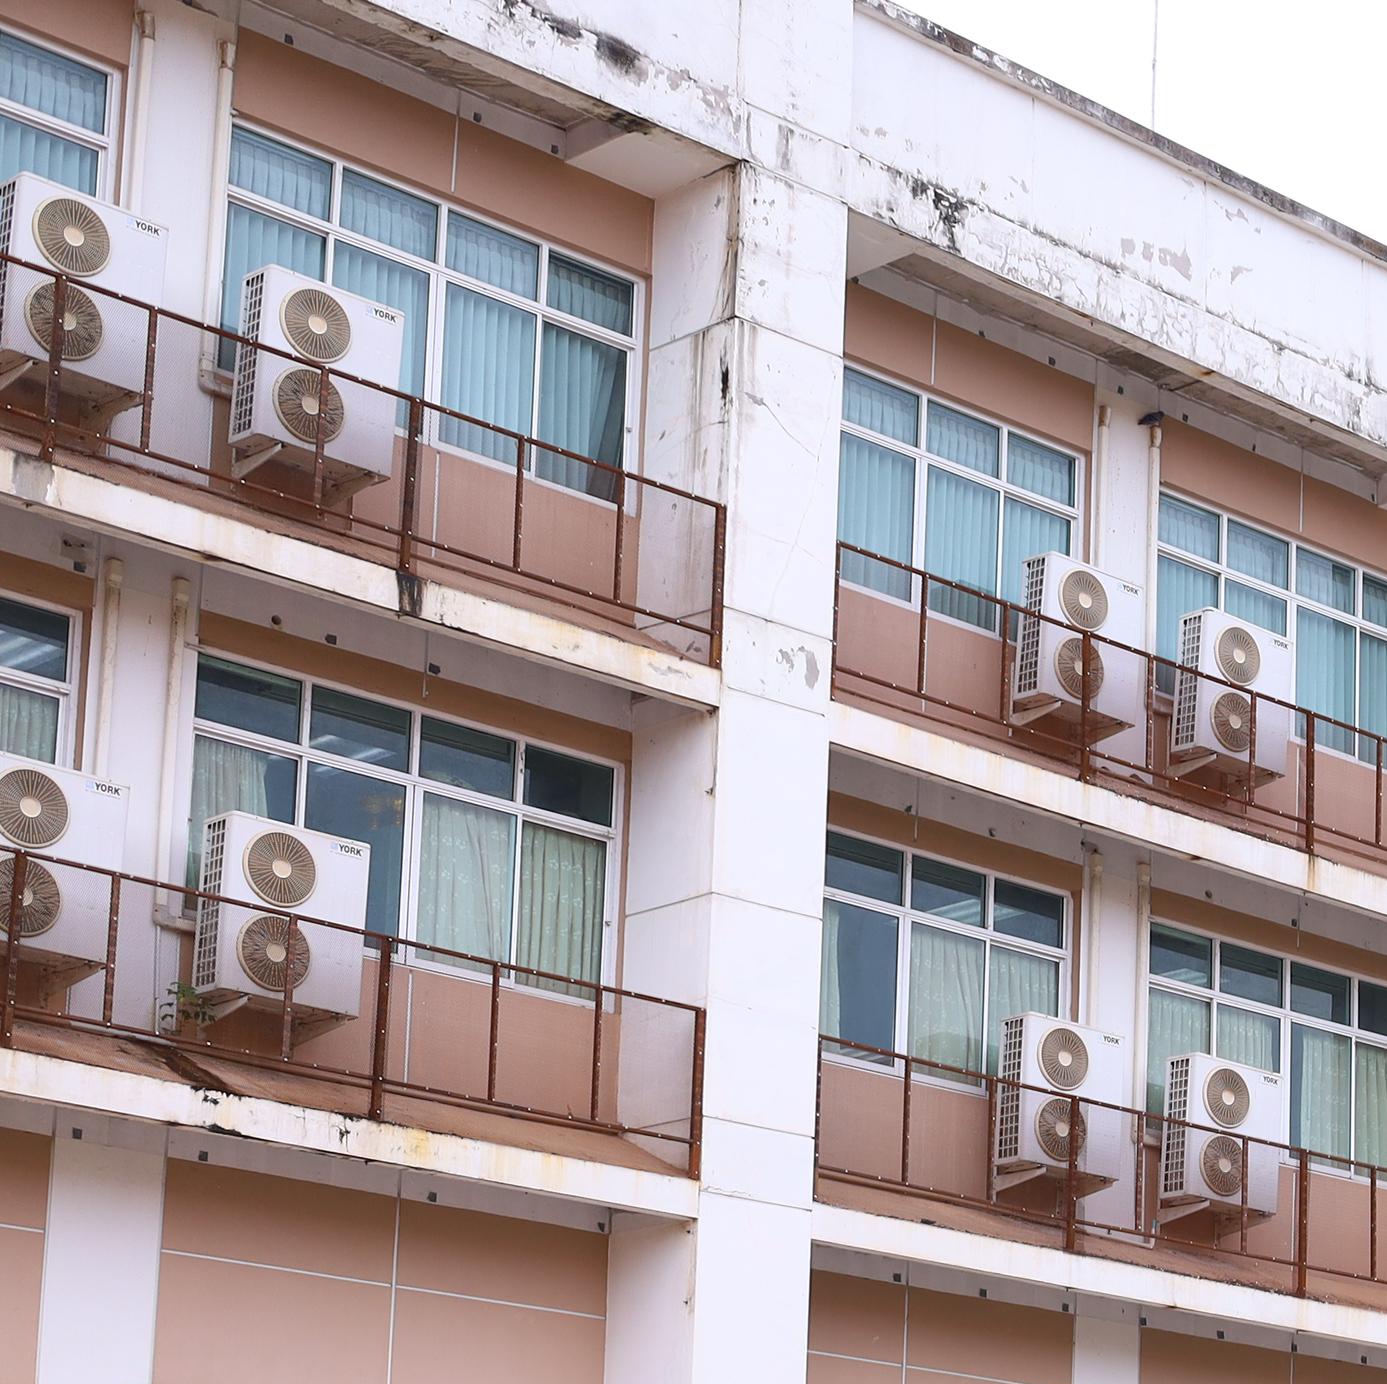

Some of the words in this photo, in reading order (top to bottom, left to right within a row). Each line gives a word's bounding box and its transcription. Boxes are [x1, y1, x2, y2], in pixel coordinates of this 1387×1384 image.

[135, 219, 160, 237] YORK
[373, 307, 397, 323] YORK
[1273, 639, 1289, 650] YORK
[95, 781, 121, 796] YORK
[338, 843, 362, 857] YORK
[1102, 1034, 1120, 1046] YORK
